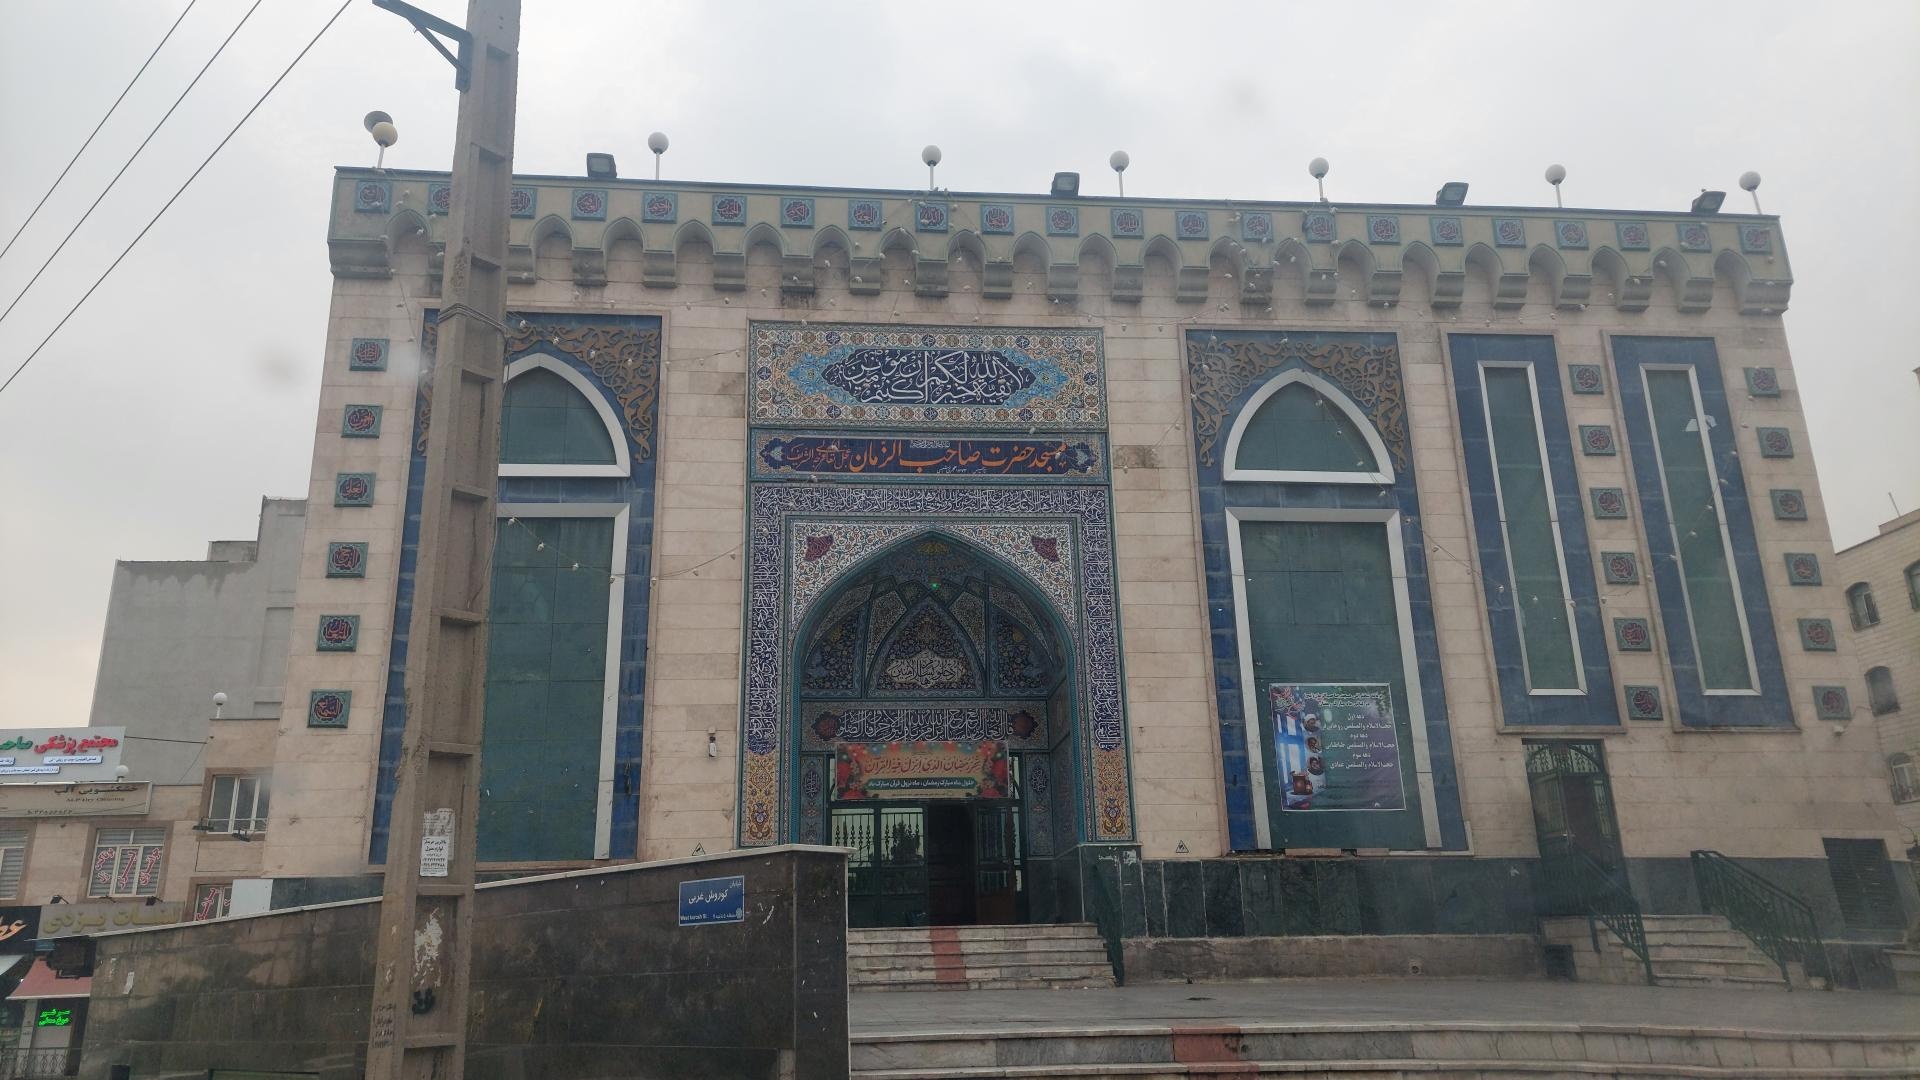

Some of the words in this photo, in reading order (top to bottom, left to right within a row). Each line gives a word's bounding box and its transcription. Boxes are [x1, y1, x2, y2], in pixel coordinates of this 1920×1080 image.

[849, 439, 902, 473] الزمان
[900, 439, 981, 474] صاحب
[980, 445, 1036, 474] حضرت
[1027, 442, 1068, 472] مسجد
[34, 734, 77, 755] پزشکی
[77, 734, 119, 753] مجتمع
[943, 757, 969, 772] رمضان
[78, 785, 139, 795] خشکشویی
[688, 891, 704, 904] غربی
[704, 888, 729, 903] کوروش
